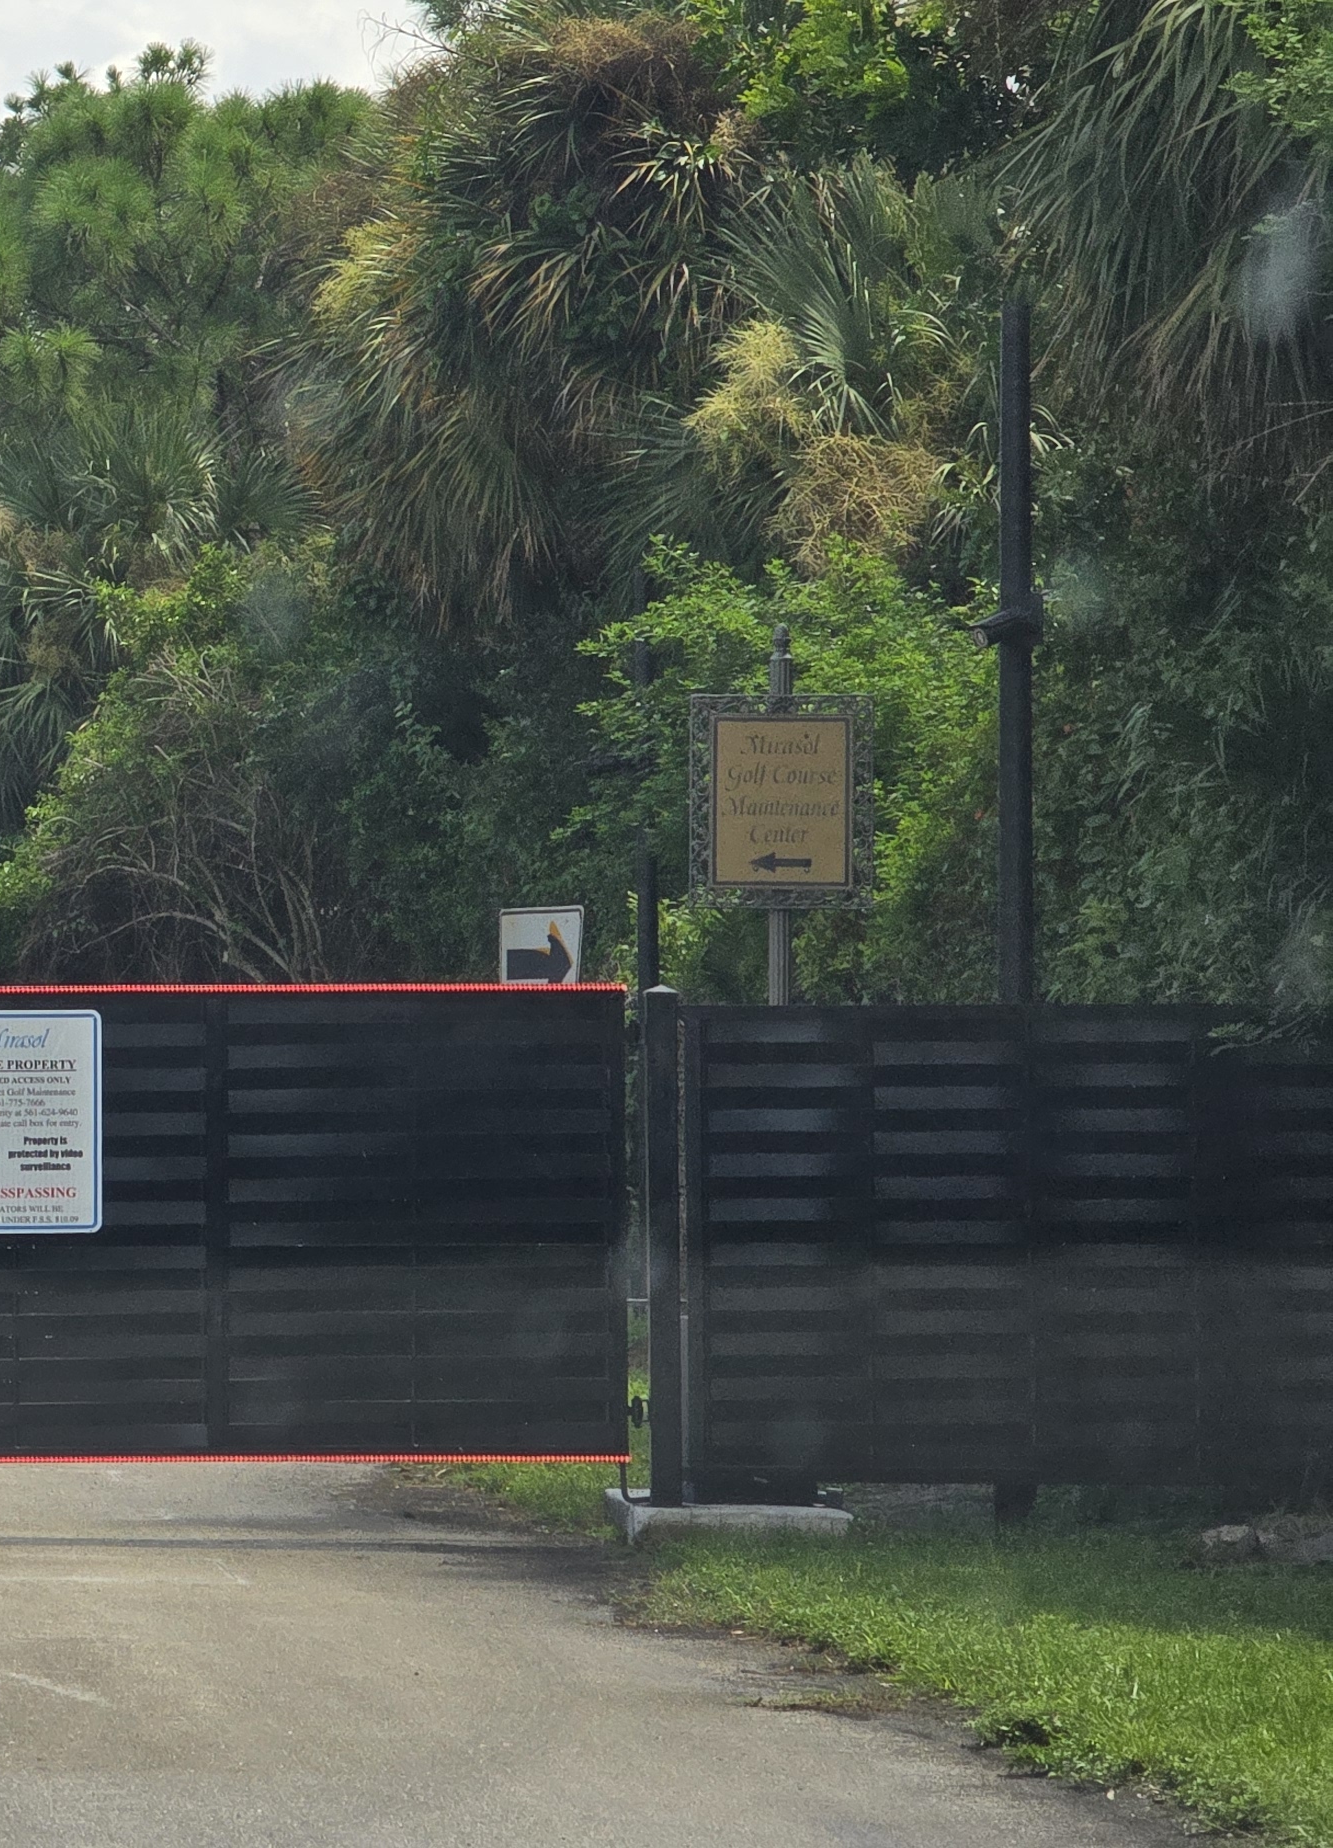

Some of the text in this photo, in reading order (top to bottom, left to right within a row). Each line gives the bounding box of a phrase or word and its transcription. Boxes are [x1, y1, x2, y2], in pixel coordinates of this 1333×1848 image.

[725, 762, 839, 791] Golf Course
[722, 796, 840, 817] Maintenance
[749, 825, 809, 843] Center
[7, 1059, 77, 1071] PROPERTY
[7, 1088, 25, 1096] Golf
[27, 1088, 76, 1096] Maintenance
[60, 1120, 82, 1128] entry.
[24, 1136, 68, 1146] Property is
[8, 1149, 83, 1159] protected by video
[20, 1163, 71, 1171] surveillance
[2, 1216, 31, 1224] UNDER
